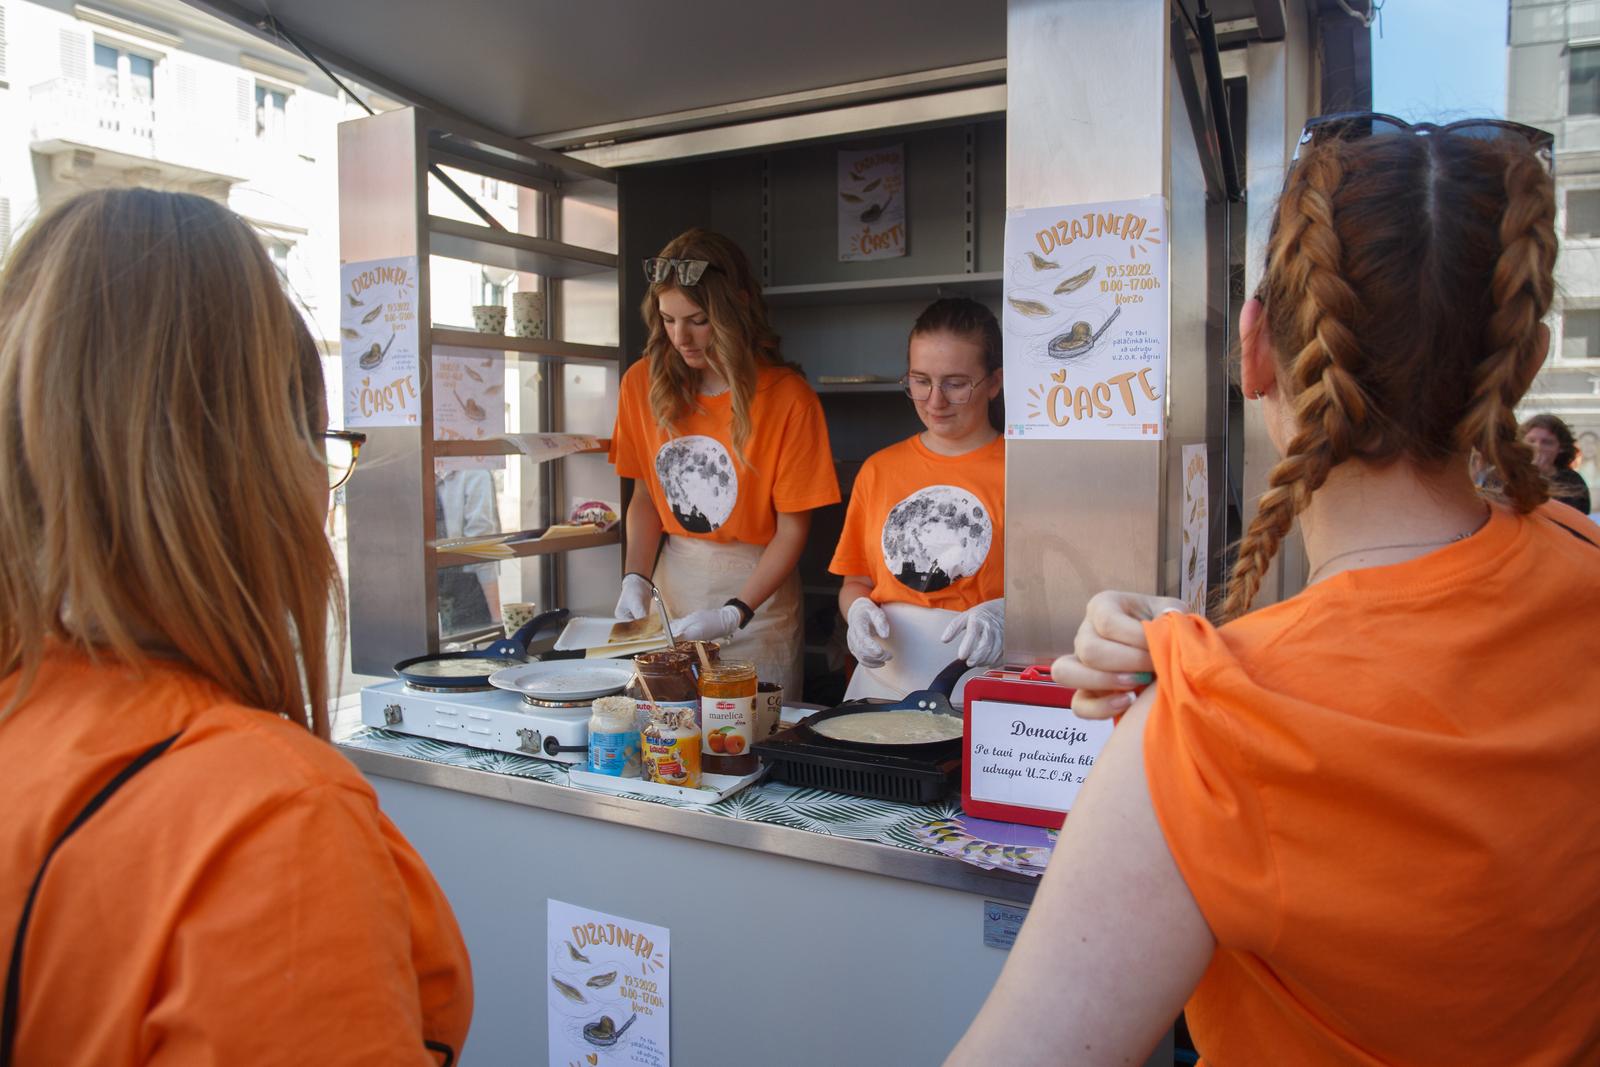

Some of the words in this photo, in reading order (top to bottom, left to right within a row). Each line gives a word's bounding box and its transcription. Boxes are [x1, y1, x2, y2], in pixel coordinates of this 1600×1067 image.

[1036, 213, 1147, 255] DIZAJNERI
[352, 266, 407, 296] DIZAJNERI
[1116, 292, 1143, 305] Korzo
[359, 375, 417, 418] ČASTE
[1046, 367, 1162, 427] ČASTE
[1011, 720, 1088, 745] Donacija
[974, 744, 989, 755] Po
[992, 747, 1013, 758] tavi
[1019, 750, 1074, 765] palačinka
[1078, 755, 1094, 766] kli
[982, 764, 1022, 779] udrugu
[572, 922, 654, 959] DIZAJNERI
